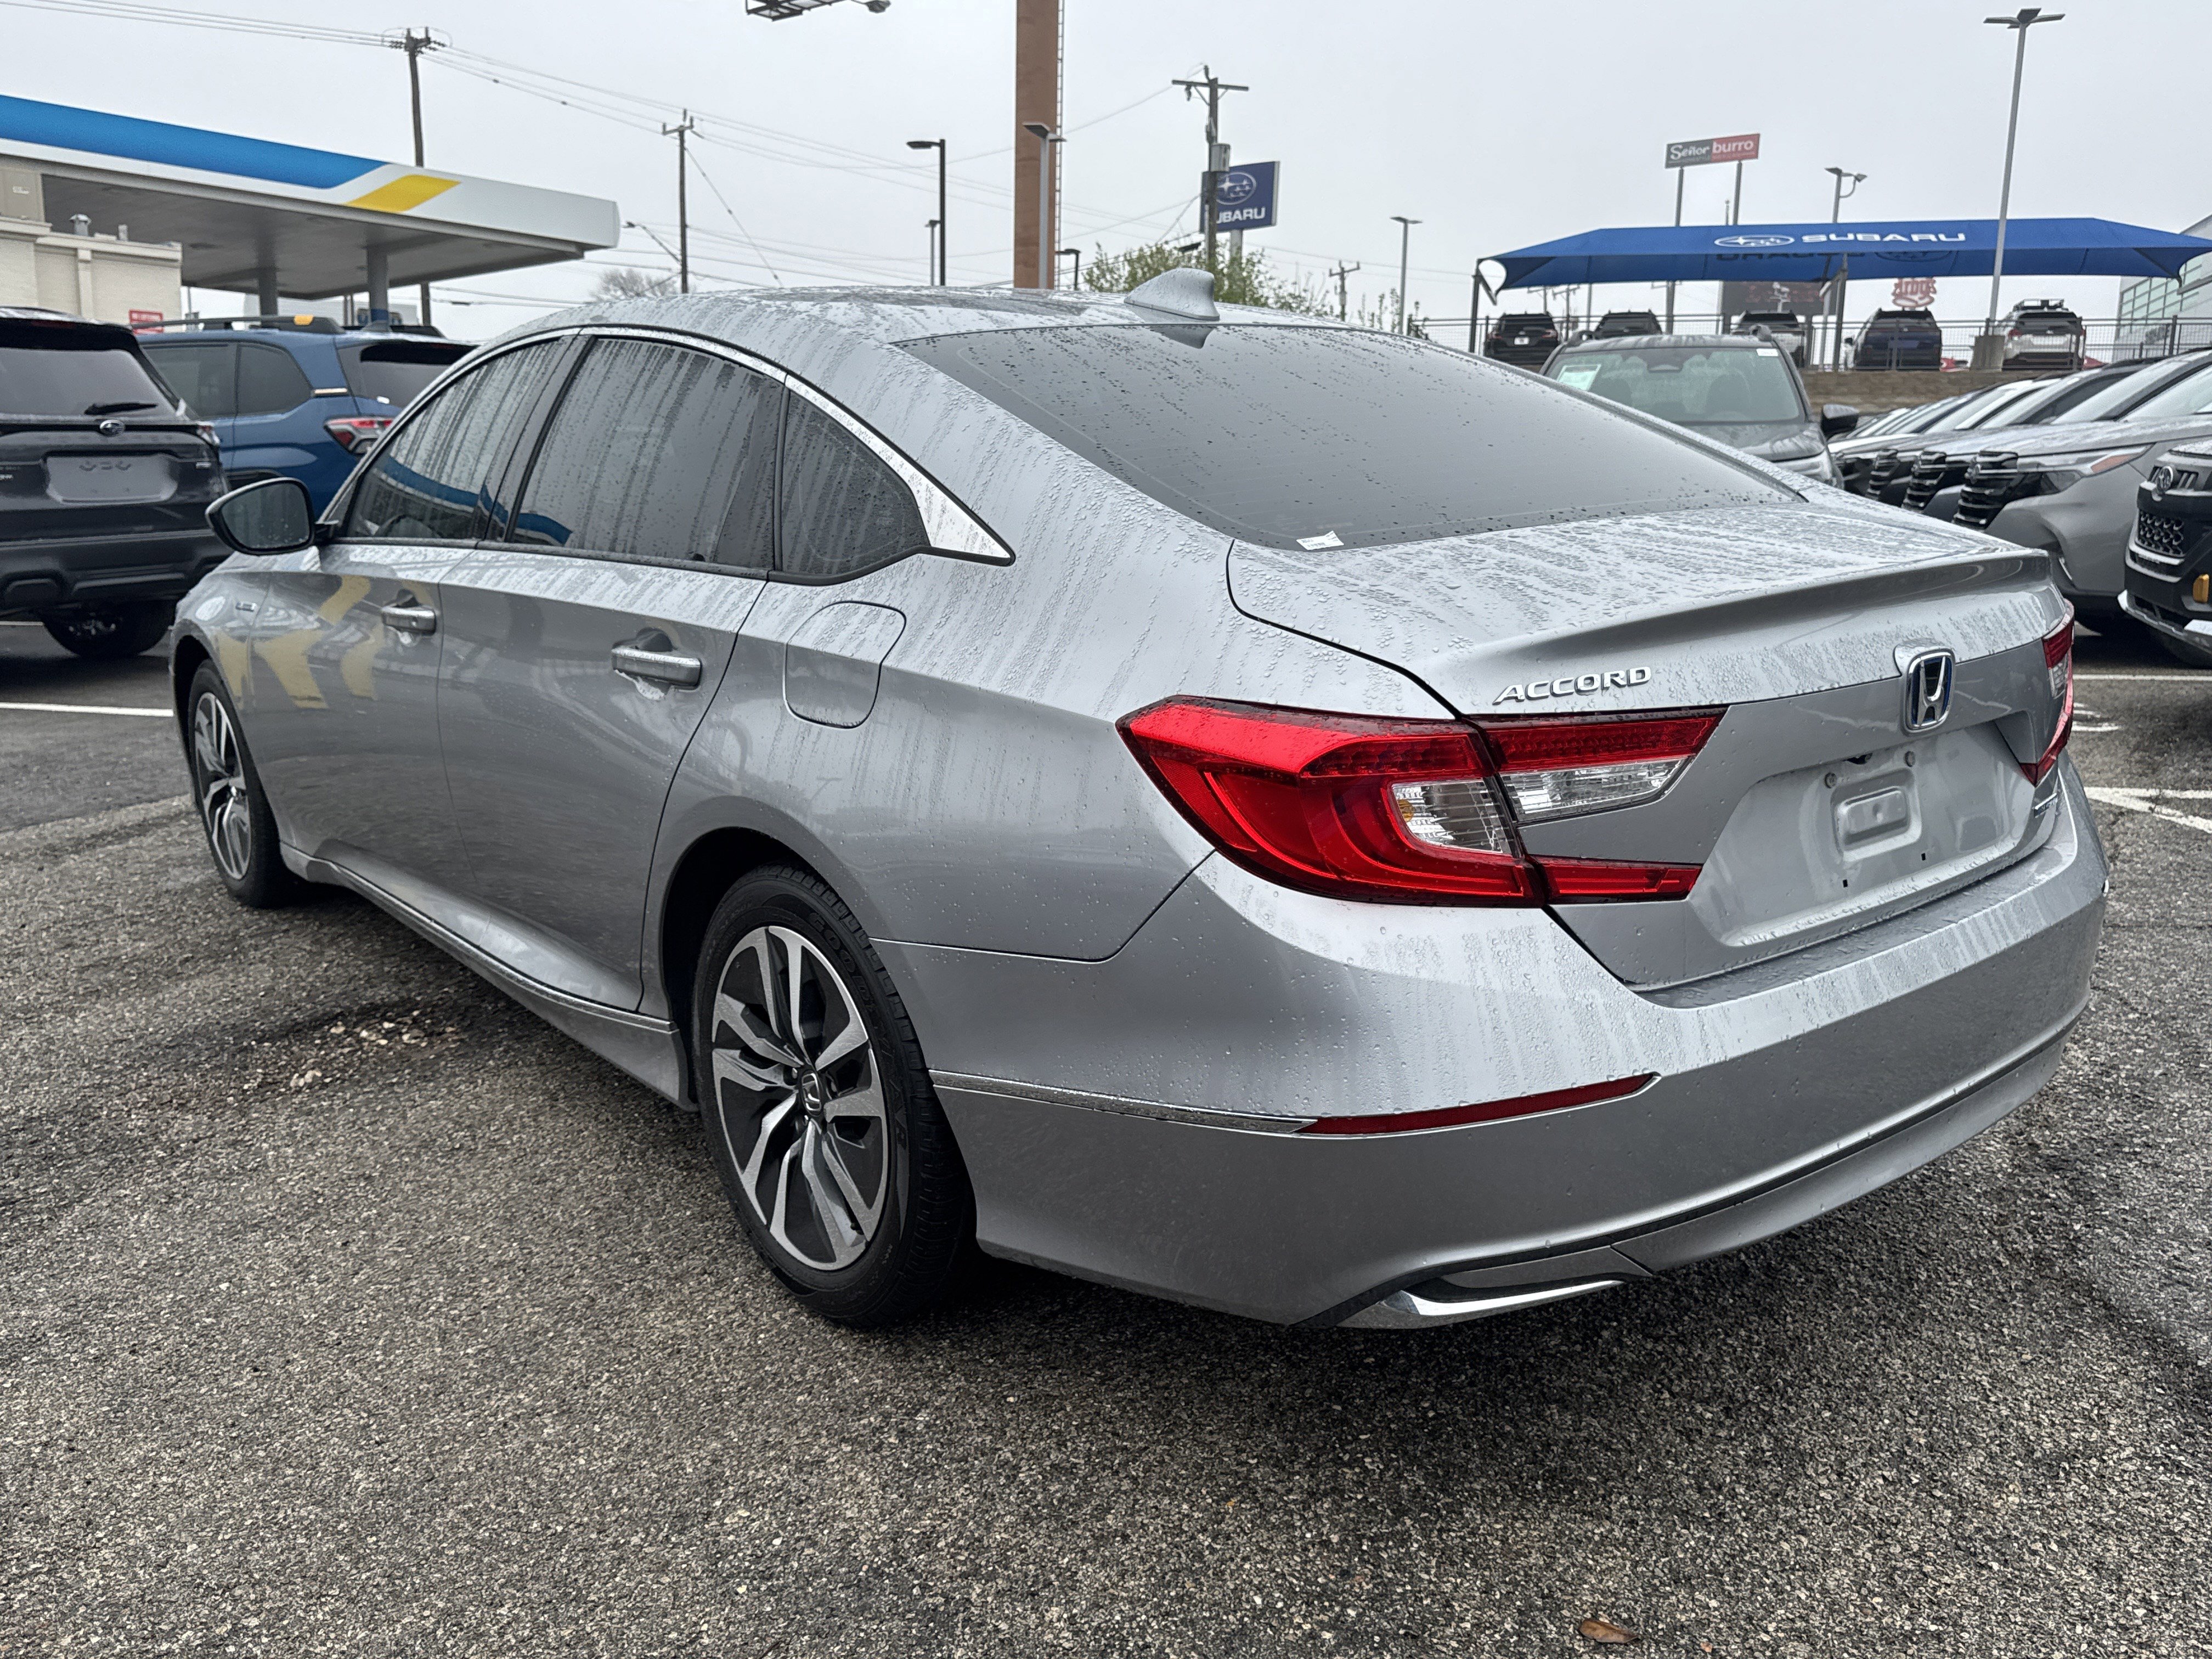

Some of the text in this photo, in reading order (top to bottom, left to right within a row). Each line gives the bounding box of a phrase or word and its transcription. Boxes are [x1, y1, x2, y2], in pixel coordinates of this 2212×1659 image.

[1712, 140, 1754, 154] burro
[1216, 207, 1265, 224] UBARU
[1802, 233, 1966, 244] SUBARU
[1492, 667, 1651, 706] ACCORD
